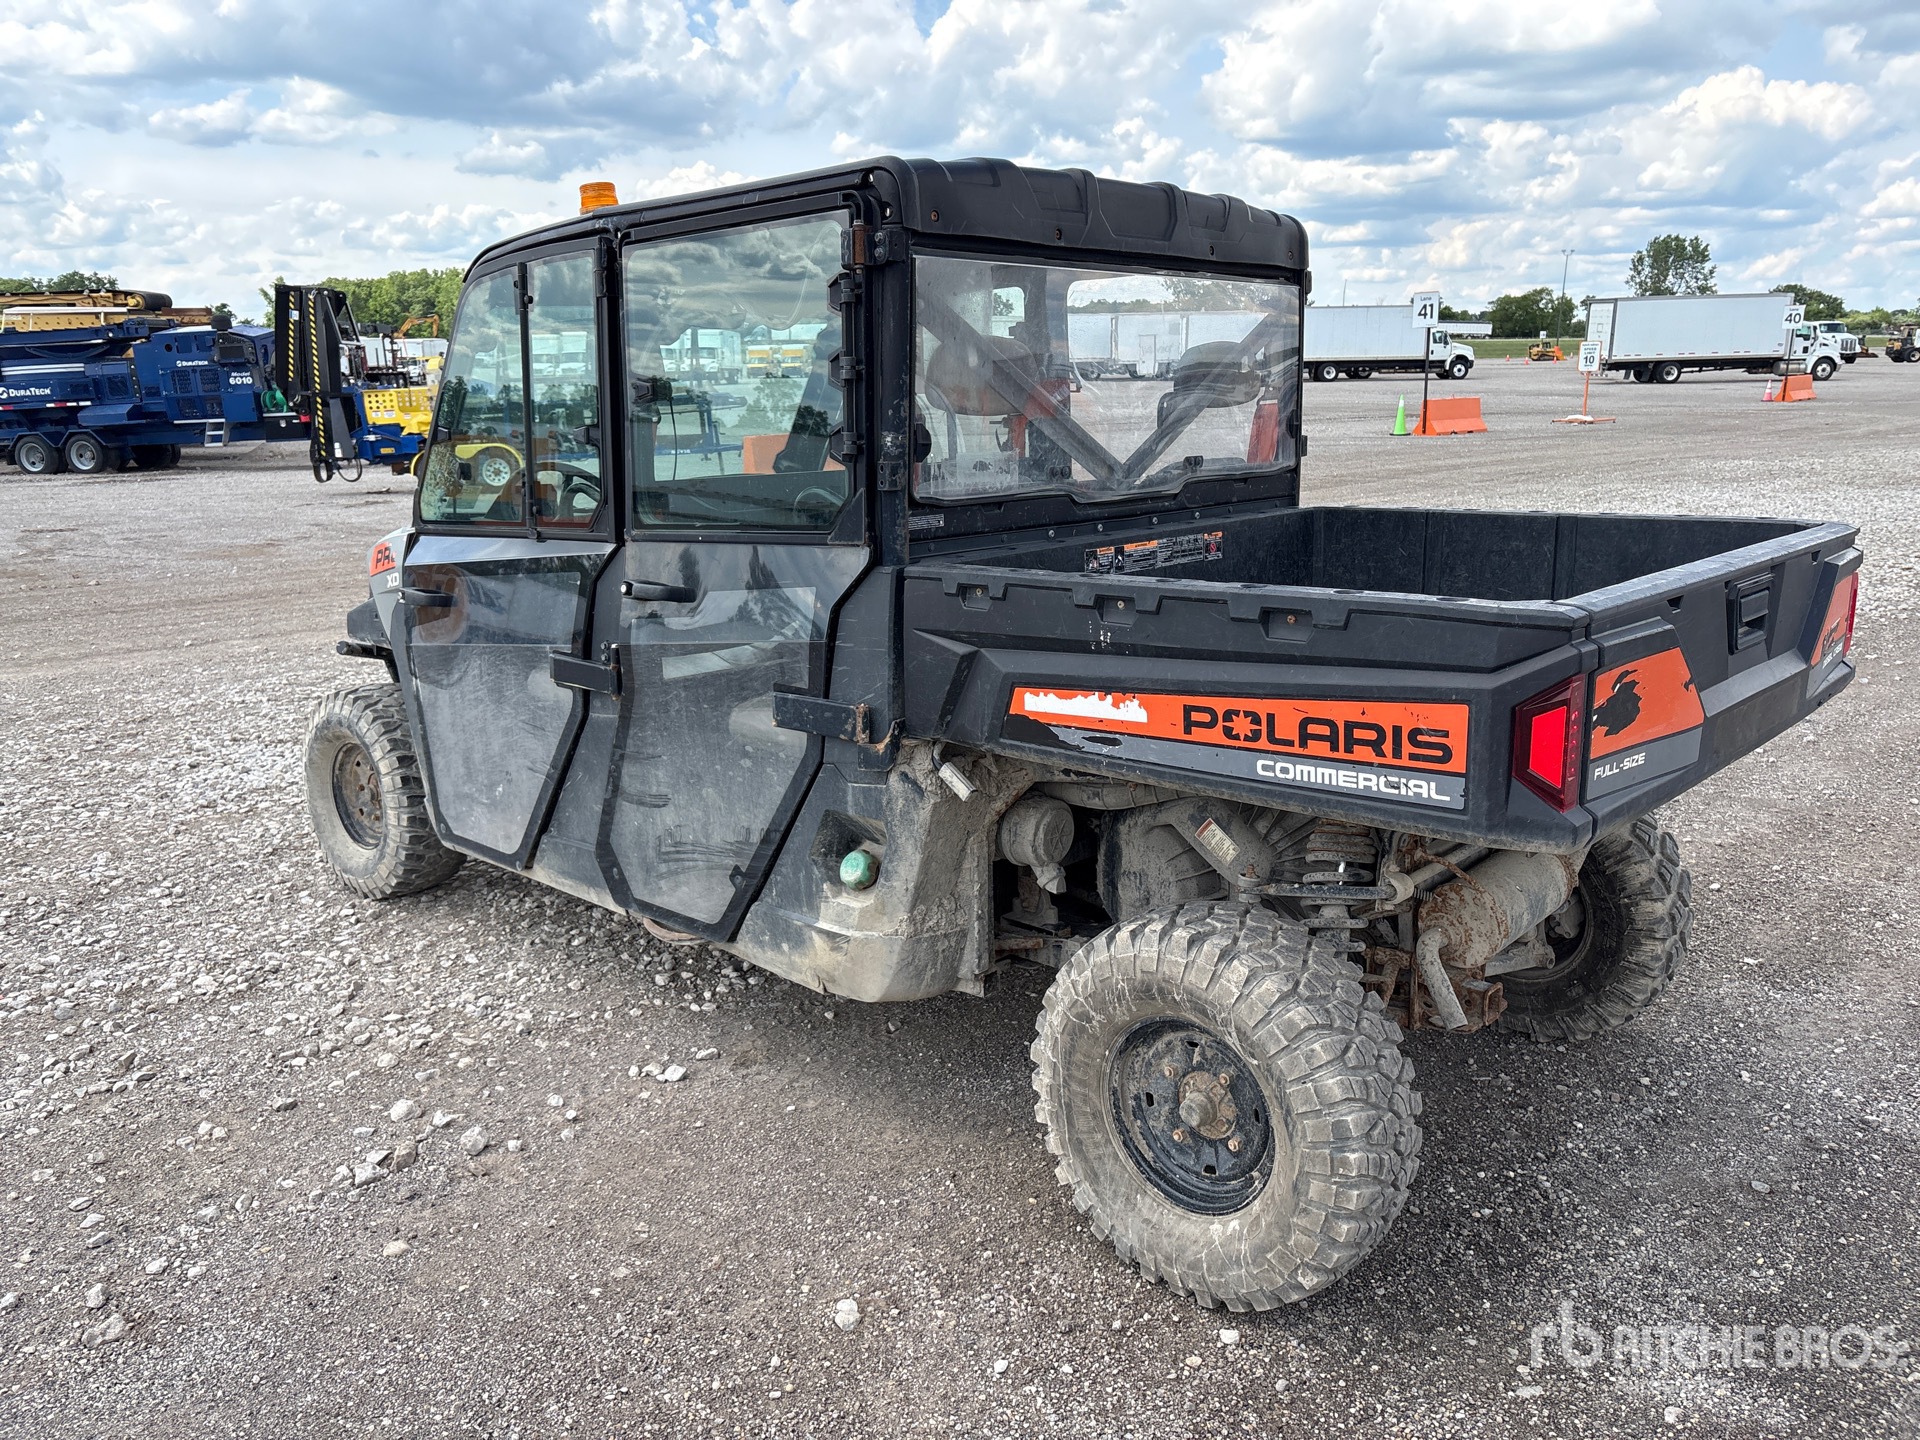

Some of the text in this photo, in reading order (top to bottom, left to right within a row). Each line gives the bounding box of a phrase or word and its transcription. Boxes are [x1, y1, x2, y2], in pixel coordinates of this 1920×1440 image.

[1417, 303, 1434, 320] 41
[1784, 312, 1802, 324] 40
[1583, 355, 1595, 365] 10
[229, 376, 253, 385] 6010
[386, 572, 400, 589] XD
[1182, 703, 1453, 765] POLARIS
[1594, 752, 1646, 781] FULL-SIZE
[1256, 759, 1451, 801] COMMERCIAL
